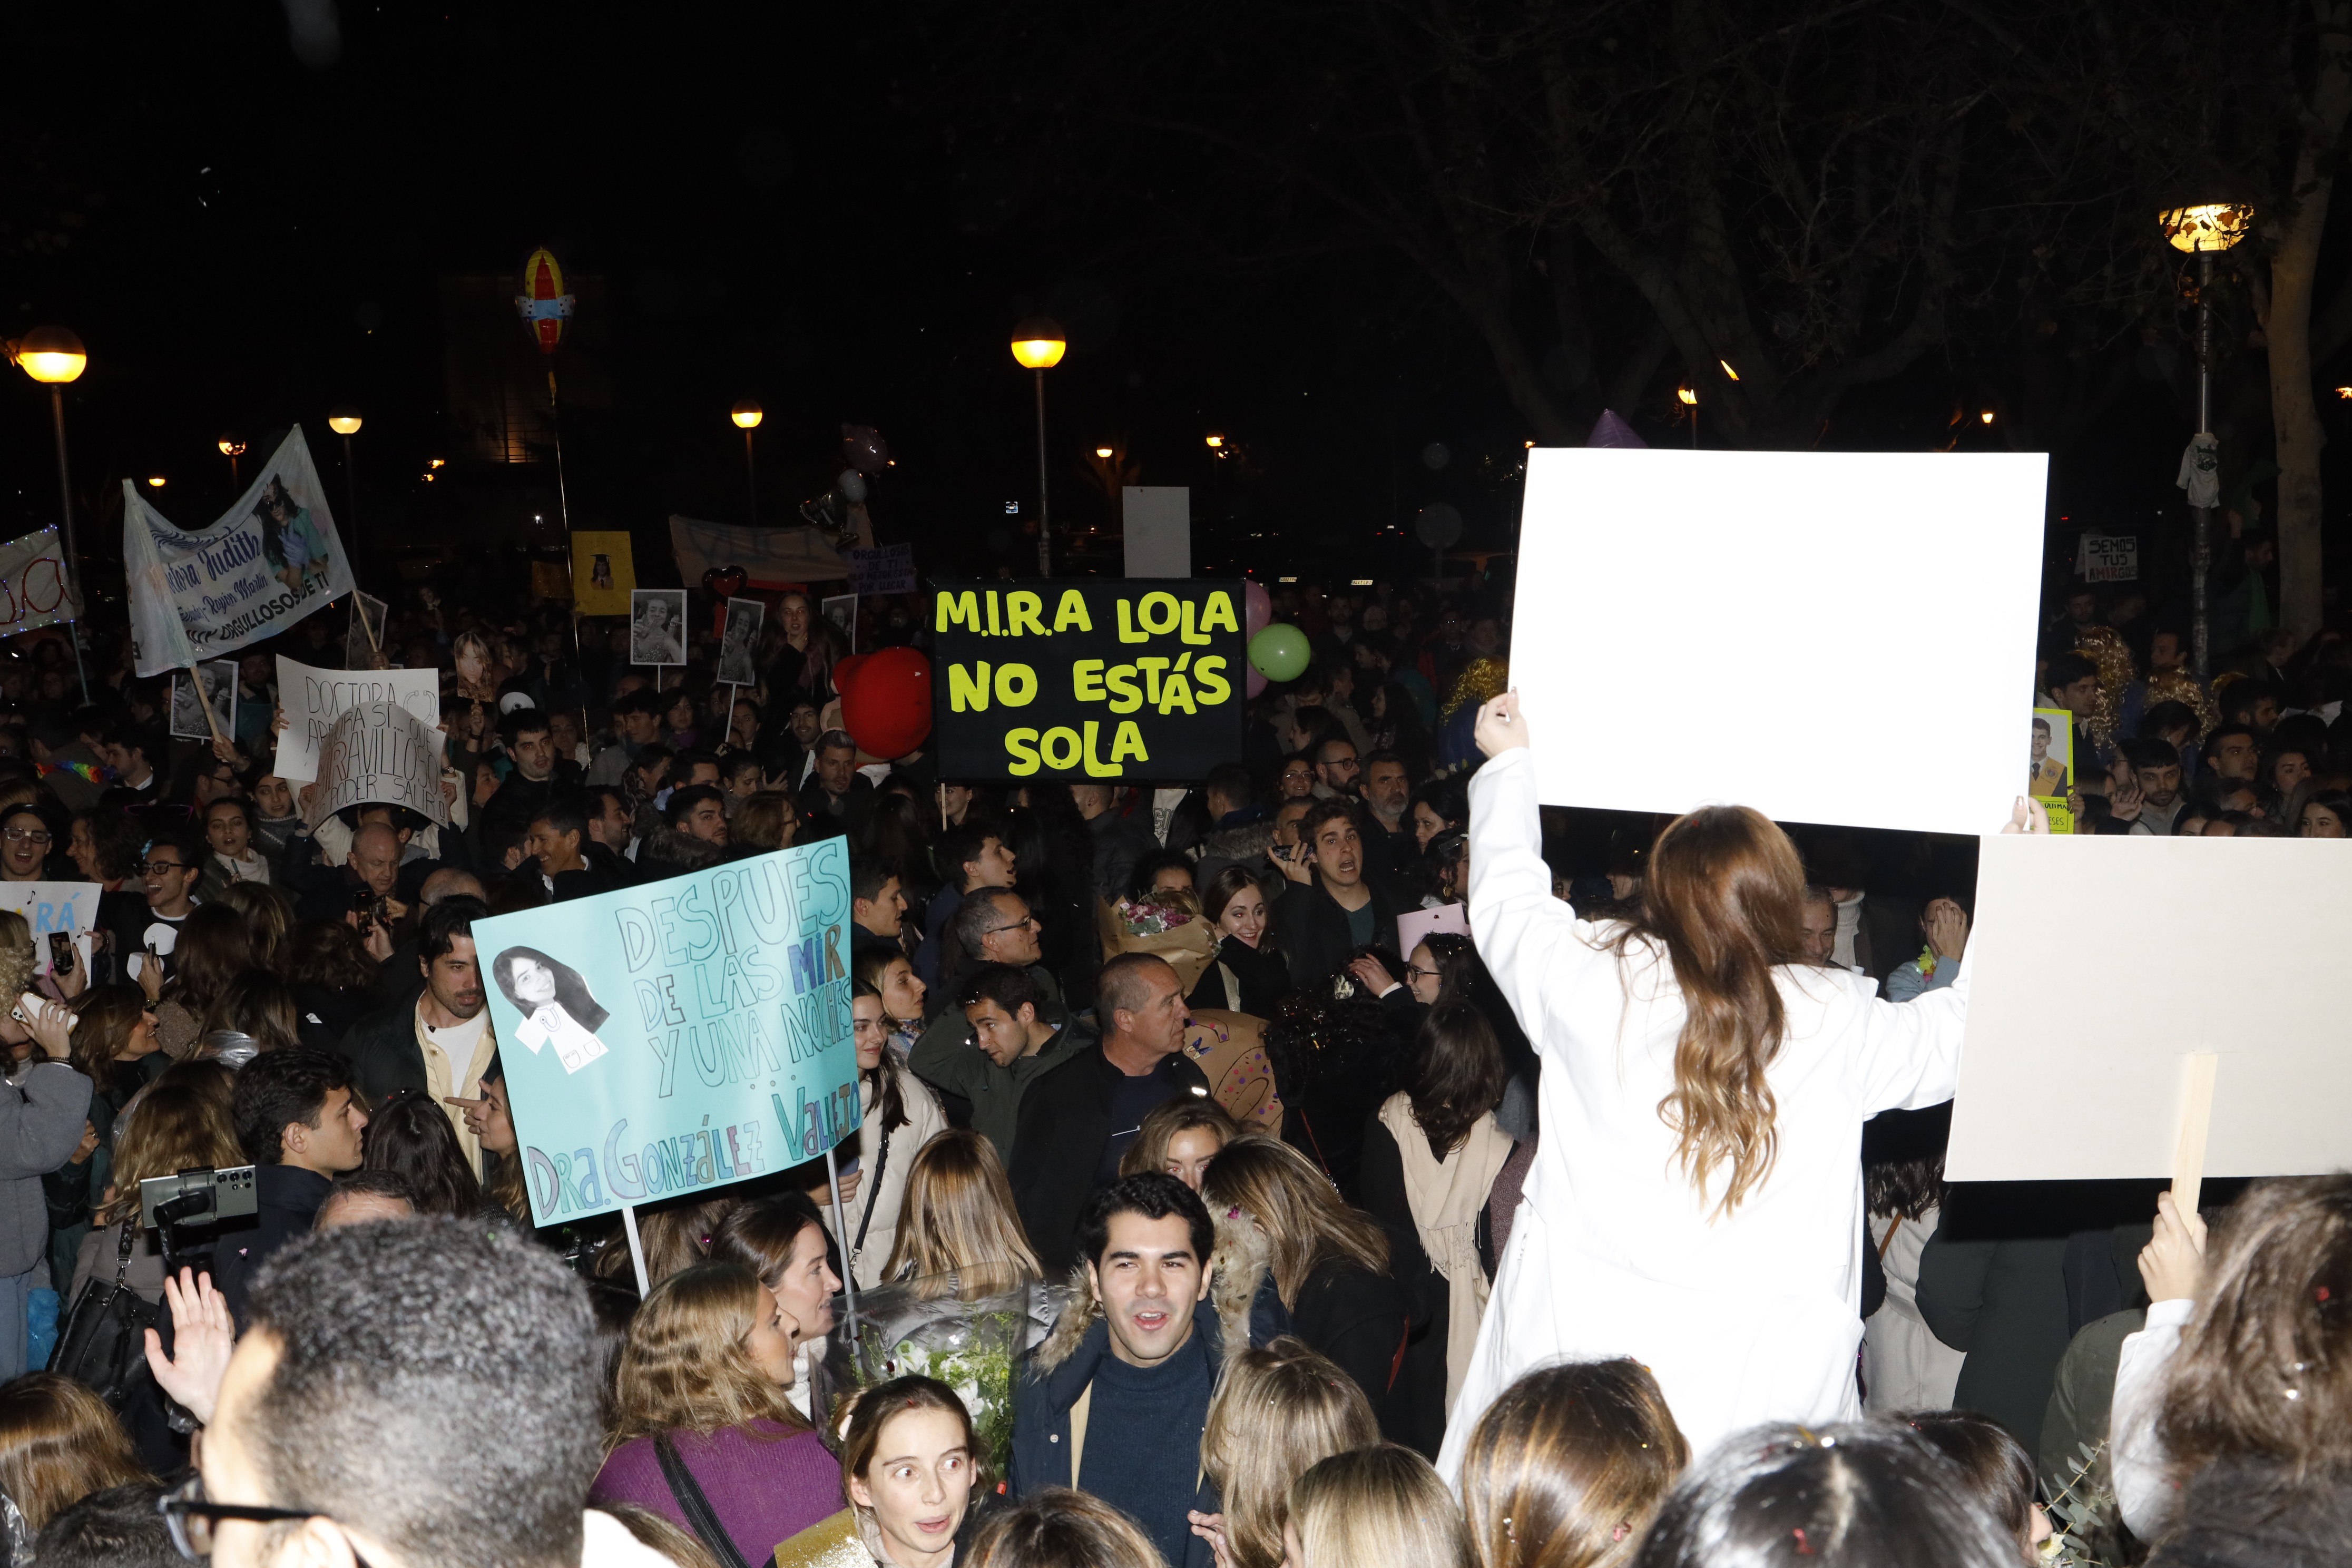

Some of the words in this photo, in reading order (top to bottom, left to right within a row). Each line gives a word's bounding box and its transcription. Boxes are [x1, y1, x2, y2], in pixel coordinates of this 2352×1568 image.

[198, 531, 260, 581] Judith
[869, 560, 881, 571] DE
[887, 559, 897, 568] TI
[2089, 538, 2135, 554] SEMOS
[2100, 554, 2128, 565] TUS
[859, 582, 875, 593] POR
[879, 580, 906, 591] LLEGAR
[867, 570, 893, 580] MEJOR
[2090, 566, 2137, 580] AMIRGOS
[220, 589, 300, 640] ORGULLOSOS
[301, 579, 316, 600] DE
[314, 571, 329, 589] TI
[936, 589, 1092, 636] M.I.R.A
[1116, 591, 1239, 645] LOLA
[948, 661, 1038, 712] NO
[1073, 651, 1231, 715] ESTÁS
[1004, 721, 1149, 777] SOLA
[330, 775, 377, 811] PODER
[392, 778, 445, 824] SALIR!
[2048, 817, 2064, 825] ESES
[615, 843, 848, 973] DESPUÉS
[633, 974, 686, 1032] DE
[694, 944, 784, 1019] LAS
[648, 1029, 679, 1099] Y
[689, 1010, 781, 1087] UNA
[780, 976, 855, 1064] NOCHES
